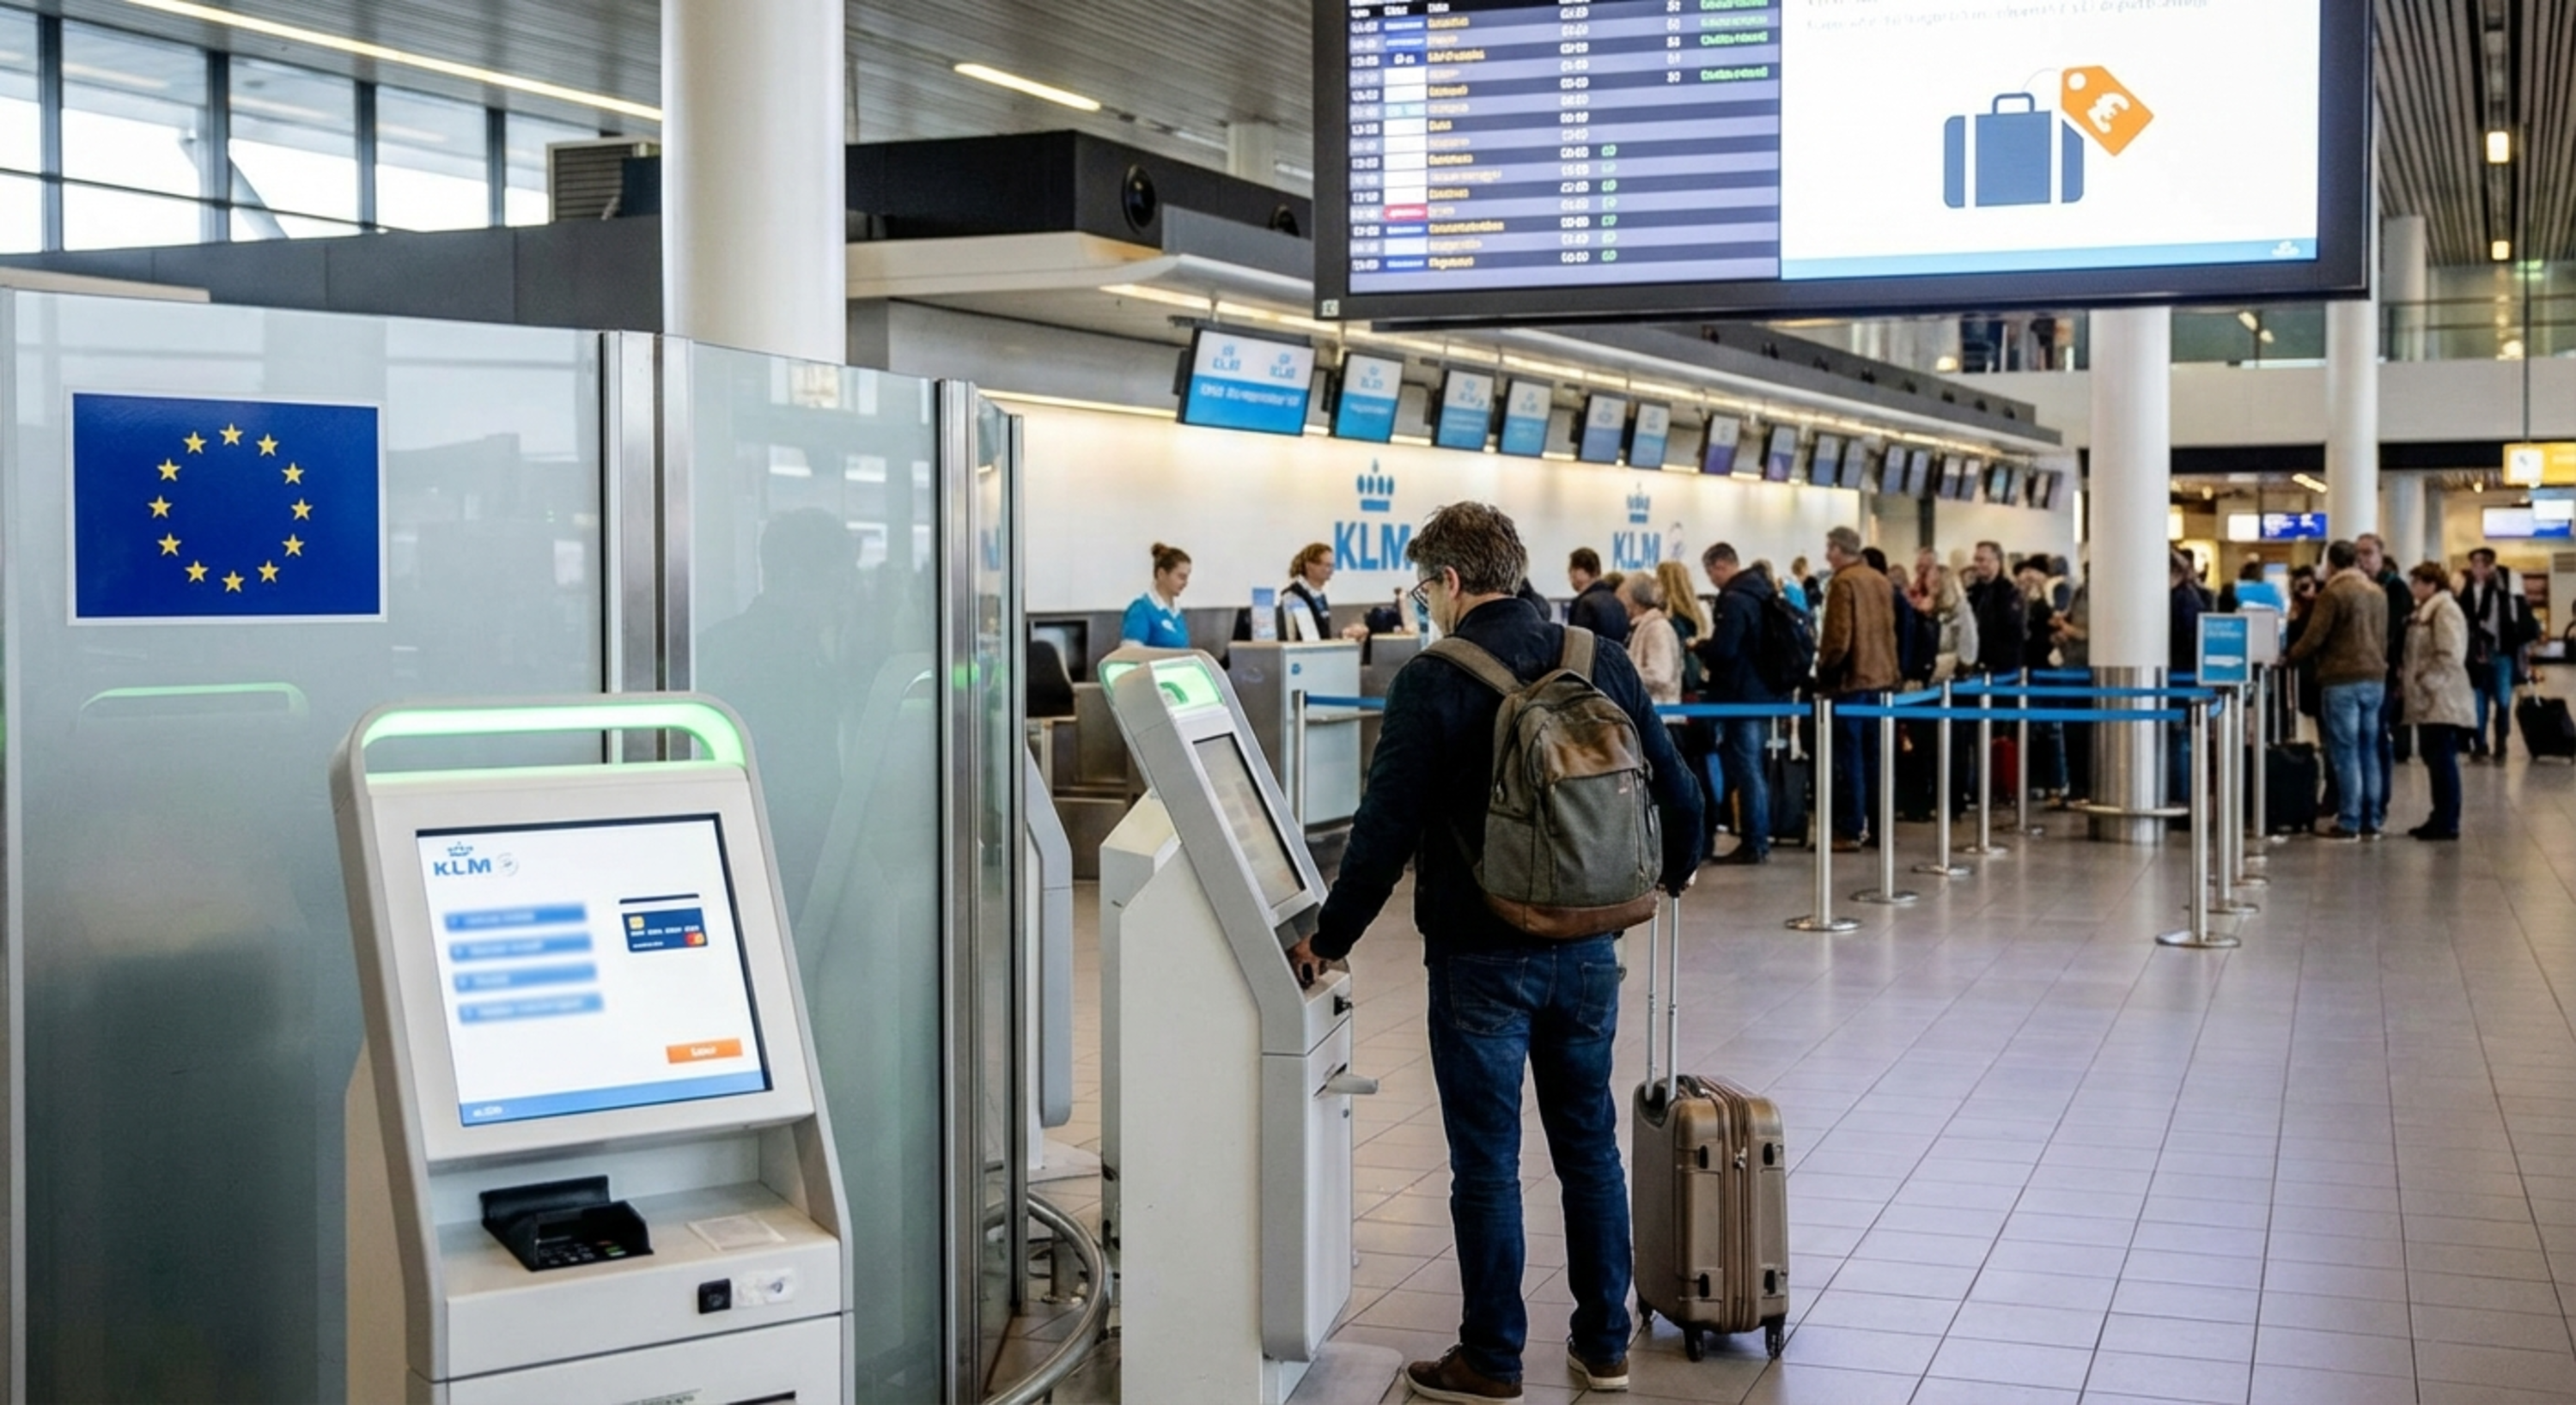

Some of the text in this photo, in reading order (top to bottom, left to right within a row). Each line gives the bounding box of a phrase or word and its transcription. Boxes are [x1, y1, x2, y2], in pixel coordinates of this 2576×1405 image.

[1335, 521, 1411, 570] KLM
[1613, 532, 1660, 569] KLM
[433, 858, 491, 876] KLM
